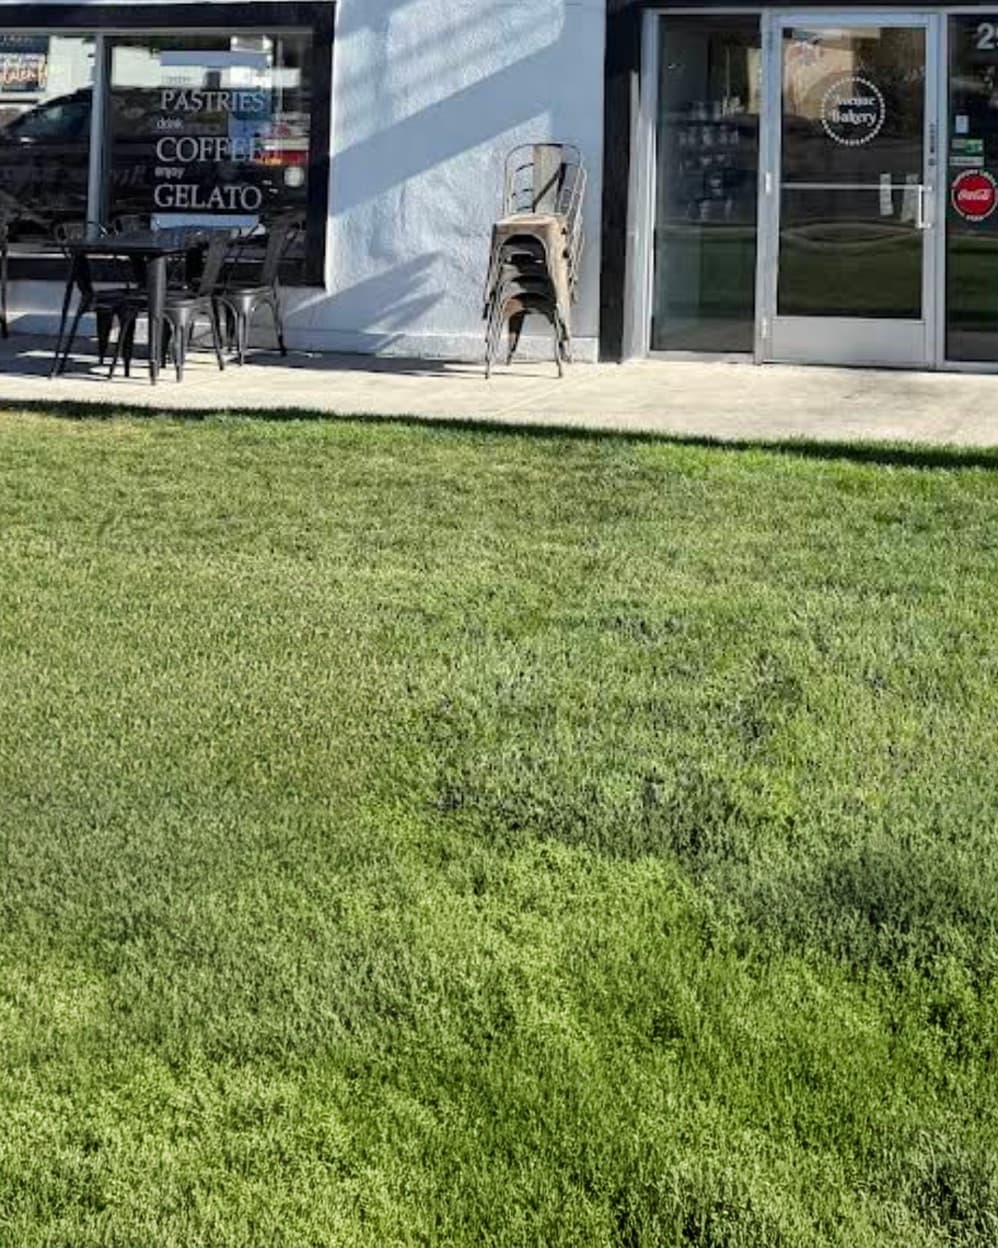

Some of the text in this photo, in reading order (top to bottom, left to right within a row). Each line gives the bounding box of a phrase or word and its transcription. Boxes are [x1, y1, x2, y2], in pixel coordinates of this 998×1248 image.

[160, 90, 265, 112] PASTRIES
[829, 108, 877, 128] Bakery
[156, 136, 264, 163] COFFEE
[154, 184, 262, 210] GELATO
